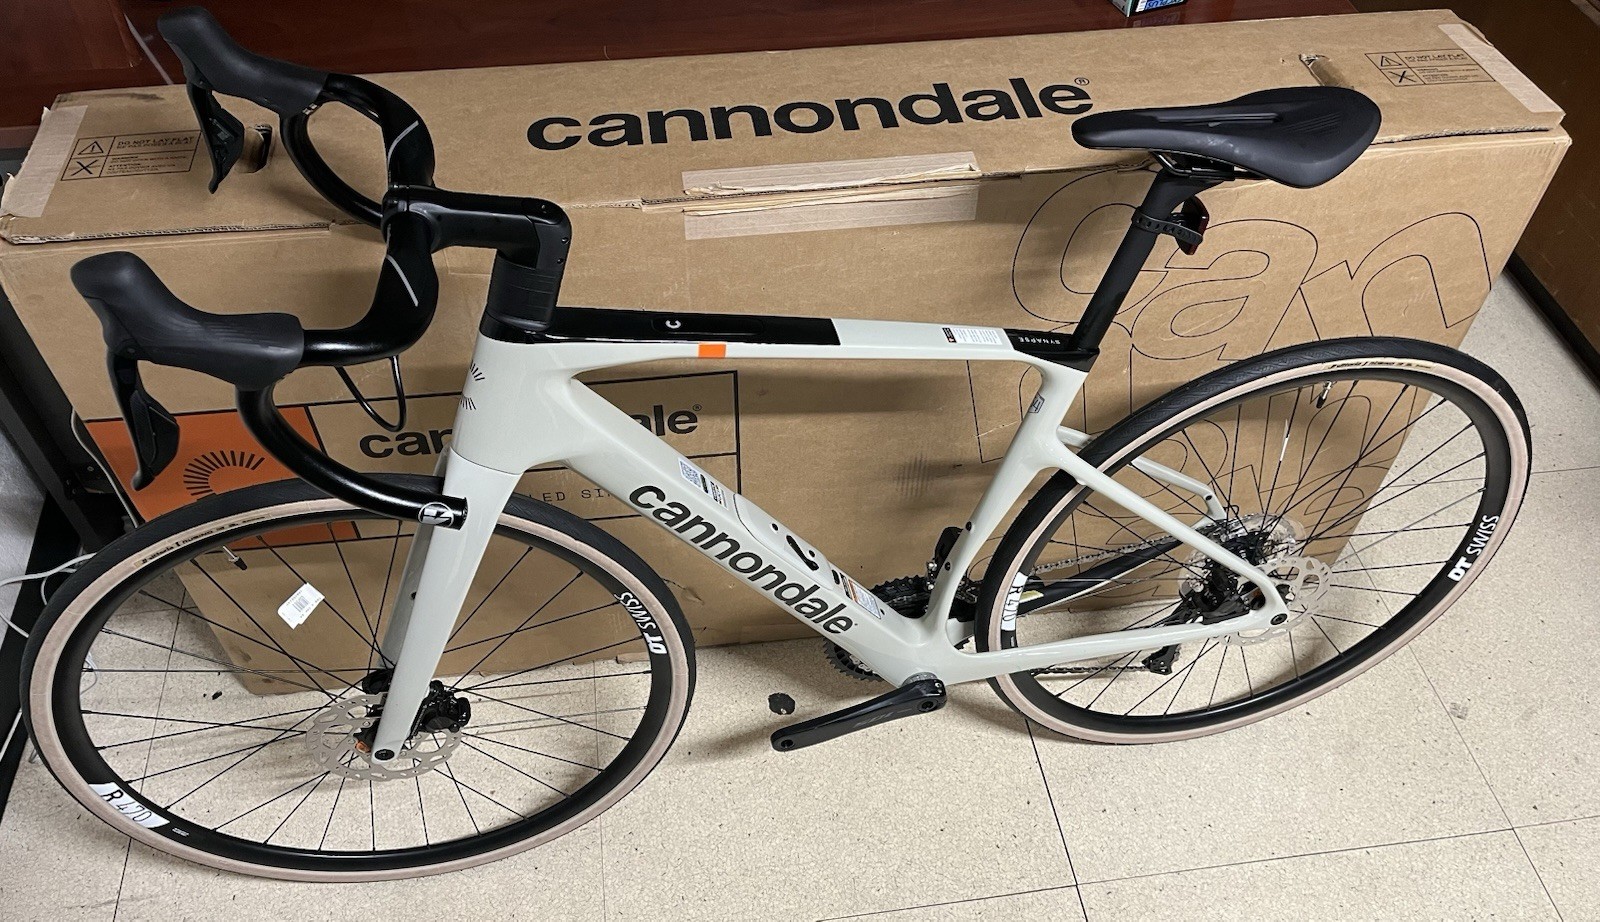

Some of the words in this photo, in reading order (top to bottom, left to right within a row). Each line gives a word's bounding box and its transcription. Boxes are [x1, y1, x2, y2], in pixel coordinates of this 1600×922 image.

[1018, 335, 1062, 345] SYNAPSE
[1447, 556, 1473, 582] DT
[1466, 514, 1500, 556] SWISS
[613, 591, 657, 629] SWISS
[642, 631, 668, 655] DT
[100, 789, 124, 802] R
[115, 801, 153, 822] 470
